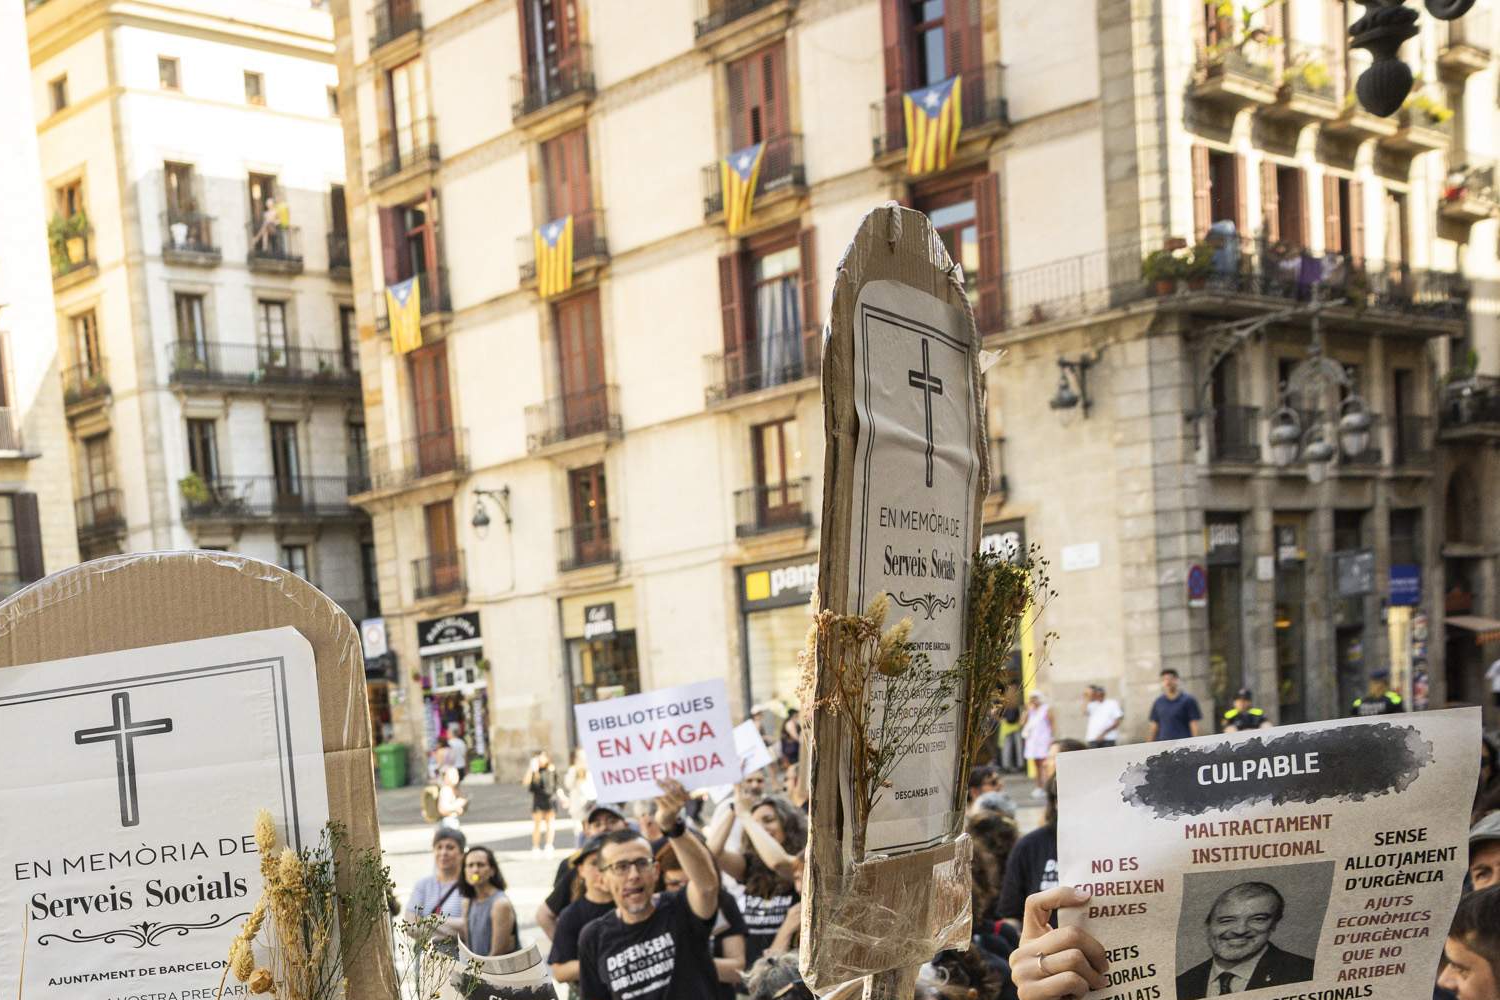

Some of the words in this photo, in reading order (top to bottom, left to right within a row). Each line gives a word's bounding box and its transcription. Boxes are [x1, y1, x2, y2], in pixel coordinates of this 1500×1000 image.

[880, 506, 897, 528] EN
[900, 508, 949, 537] MEMÒRIA
[950, 519, 960, 538] DE
[884, 545, 927, 577] Serveis
[931, 549, 956, 582] Socials
[588, 696, 714, 732] BIBLIOTEQUES
[598, 736, 632, 758] EN
[639, 720, 716, 751] VAGA
[601, 752, 724, 787] INDEFINIDA
[1197, 752, 1320, 786] CULPABLE
[895, 787, 928, 800] DESCANSA
[1185, 814, 1333, 840] MALTRACTAMENT
[1374, 828, 1428, 846] SENSE
[14, 861, 52, 882] EN
[62, 839, 210, 877] MEMÒRIA
[218, 834, 258, 857] DE
[1192, 840, 1325, 865] INSTITUCIONAL
[1344, 847, 1458, 871] ALLOTJAMENT
[1091, 859, 1113, 874] NO
[1119, 857, 1139, 871] ES
[1345, 868, 1445, 891] D'URGÈNCIA
[30, 887, 133, 922] Serveis
[145, 870, 249, 905] Socials
[1364, 895, 1414, 910] AJUTS
[1088, 902, 1147, 919] BAIXES
[1336, 909, 1431, 929] ECONÒMICS
[1333, 925, 1430, 945] D'URGÈNCIA
[1104, 945, 1139, 964] RETS
[1342, 948, 1374, 965] QUE
[1378, 945, 1402, 959] NO
[48, 968, 135, 986] AJUNTAMENT
[138, 966, 157, 977] DE
[159, 959, 231, 975] BARCELON
[1337, 963, 1406, 982] ARRIBEN
